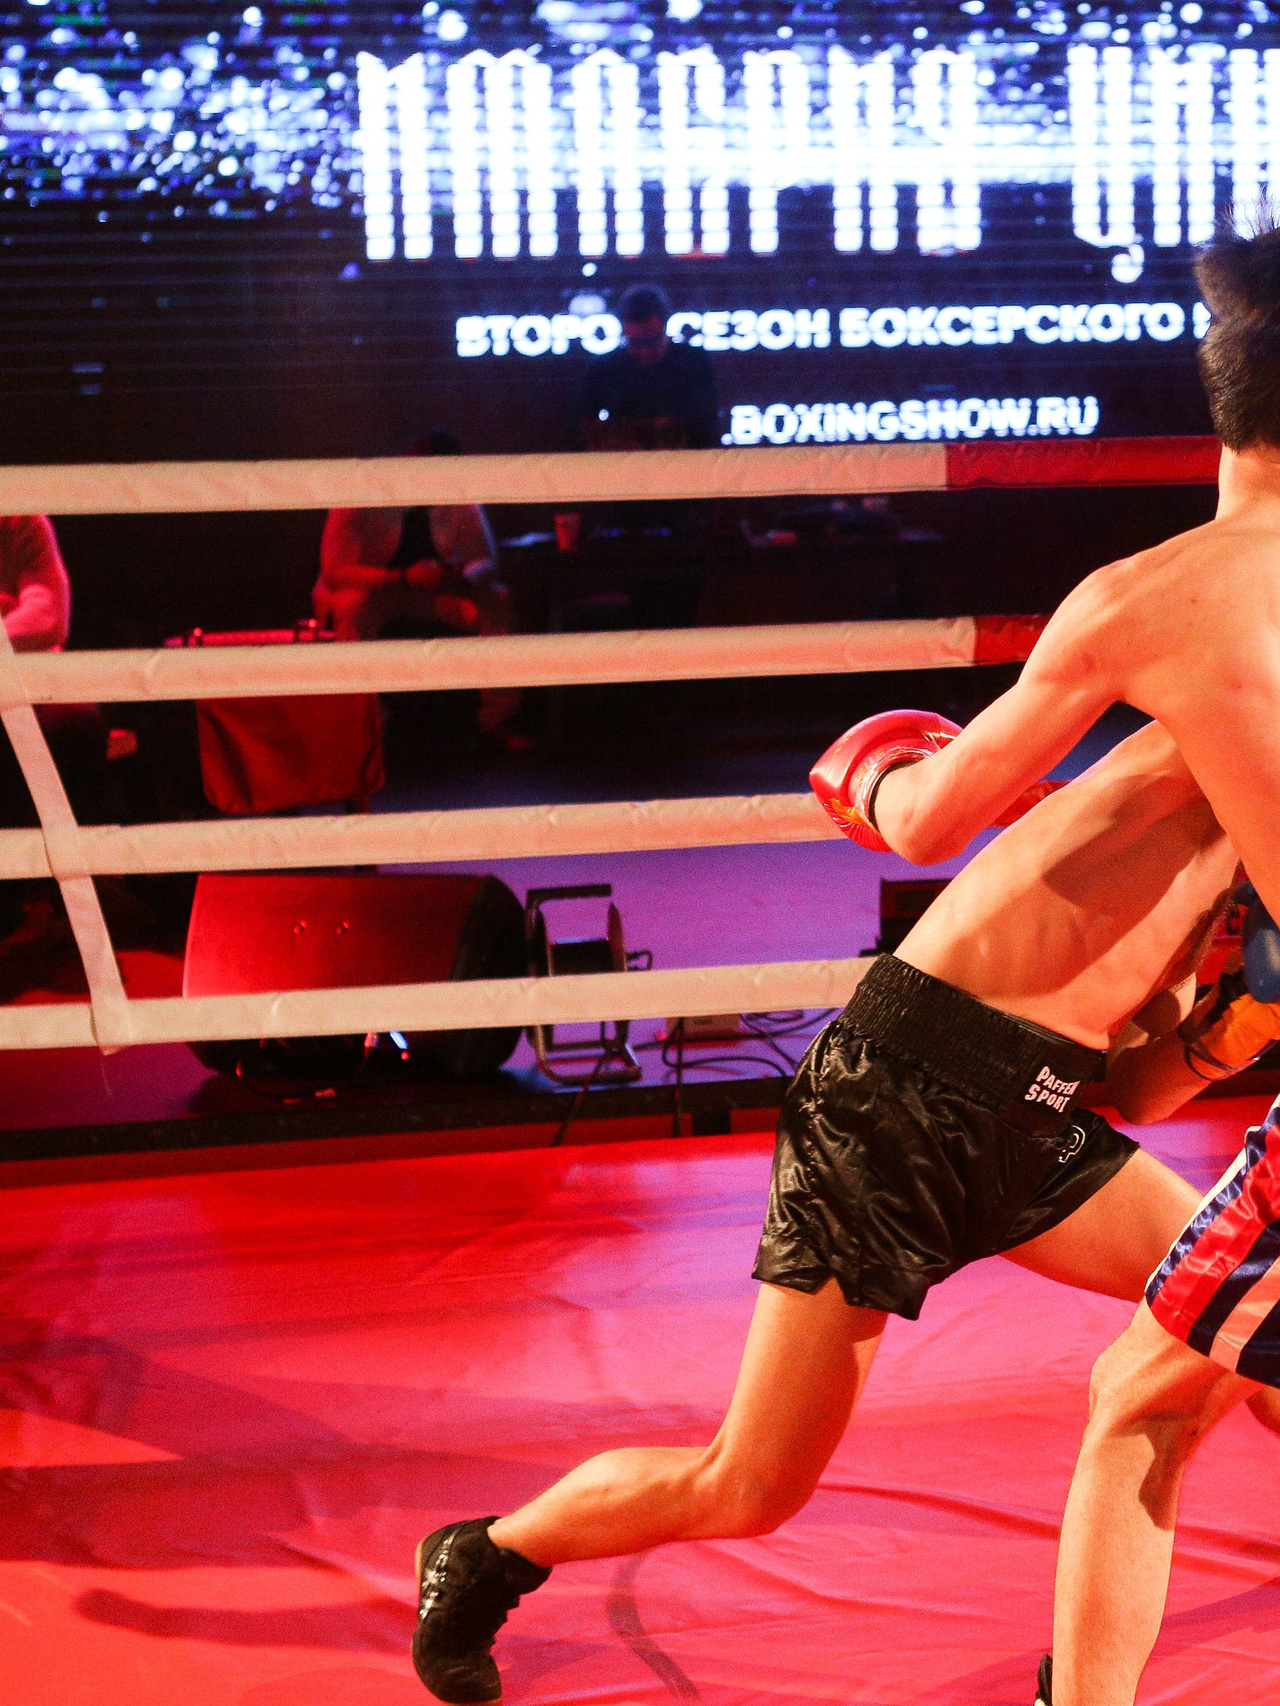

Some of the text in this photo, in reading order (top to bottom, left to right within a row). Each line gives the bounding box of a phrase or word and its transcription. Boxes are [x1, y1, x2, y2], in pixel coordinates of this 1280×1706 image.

[455, 313, 630, 358] ВТОРО
[665, 308, 831, 353] СЕЗОН
[838, 301, 1187, 350] БОКСЕРСКОГО
